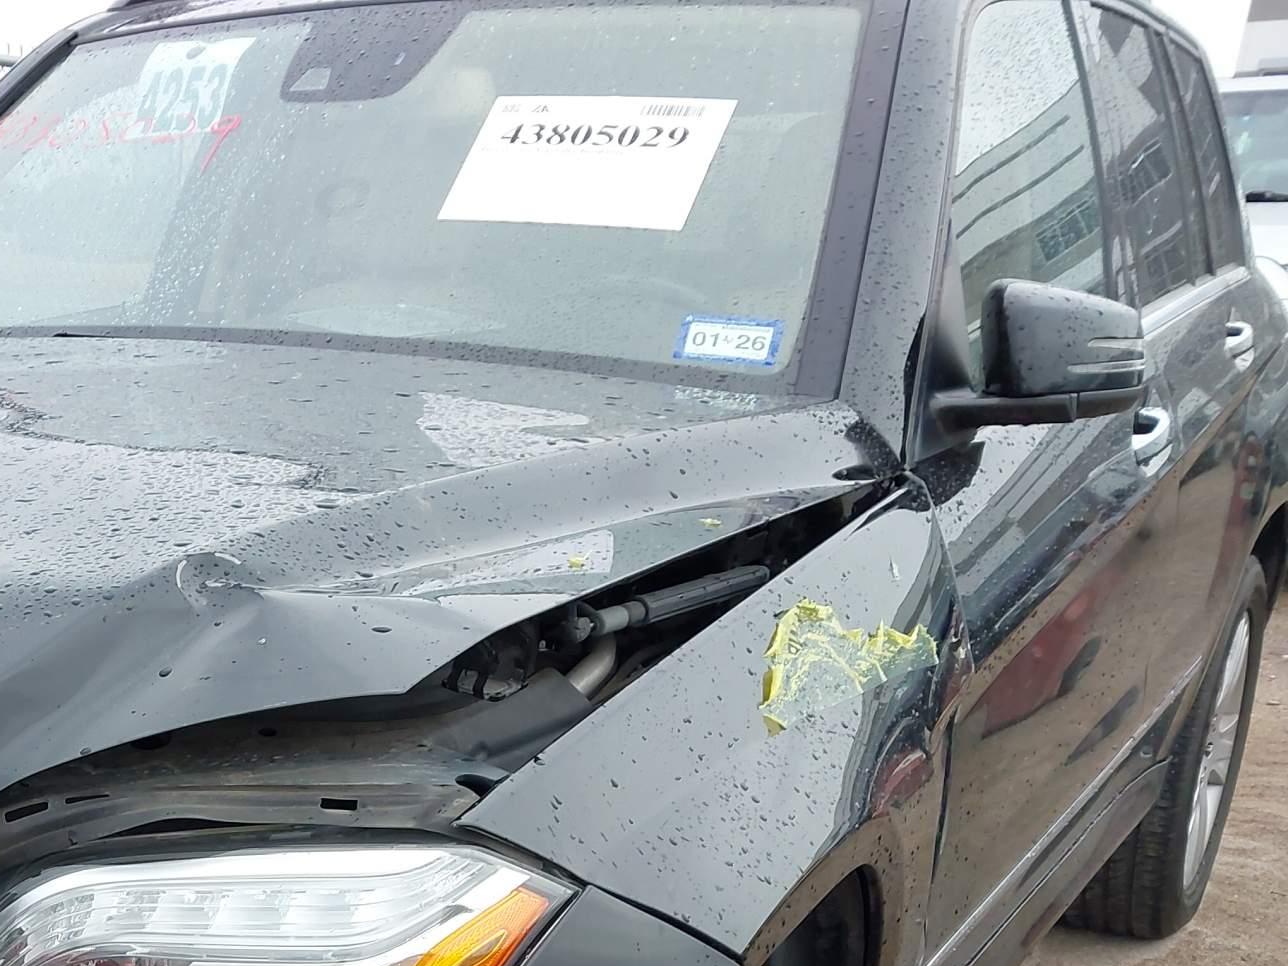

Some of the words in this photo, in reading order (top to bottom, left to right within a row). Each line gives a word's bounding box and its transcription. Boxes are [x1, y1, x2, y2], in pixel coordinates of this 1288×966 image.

[136, 63, 230, 131] 4253
[500, 123, 690, 148] 43805029
[692, 331, 720, 347] 01
[735, 334, 767, 351] 26
